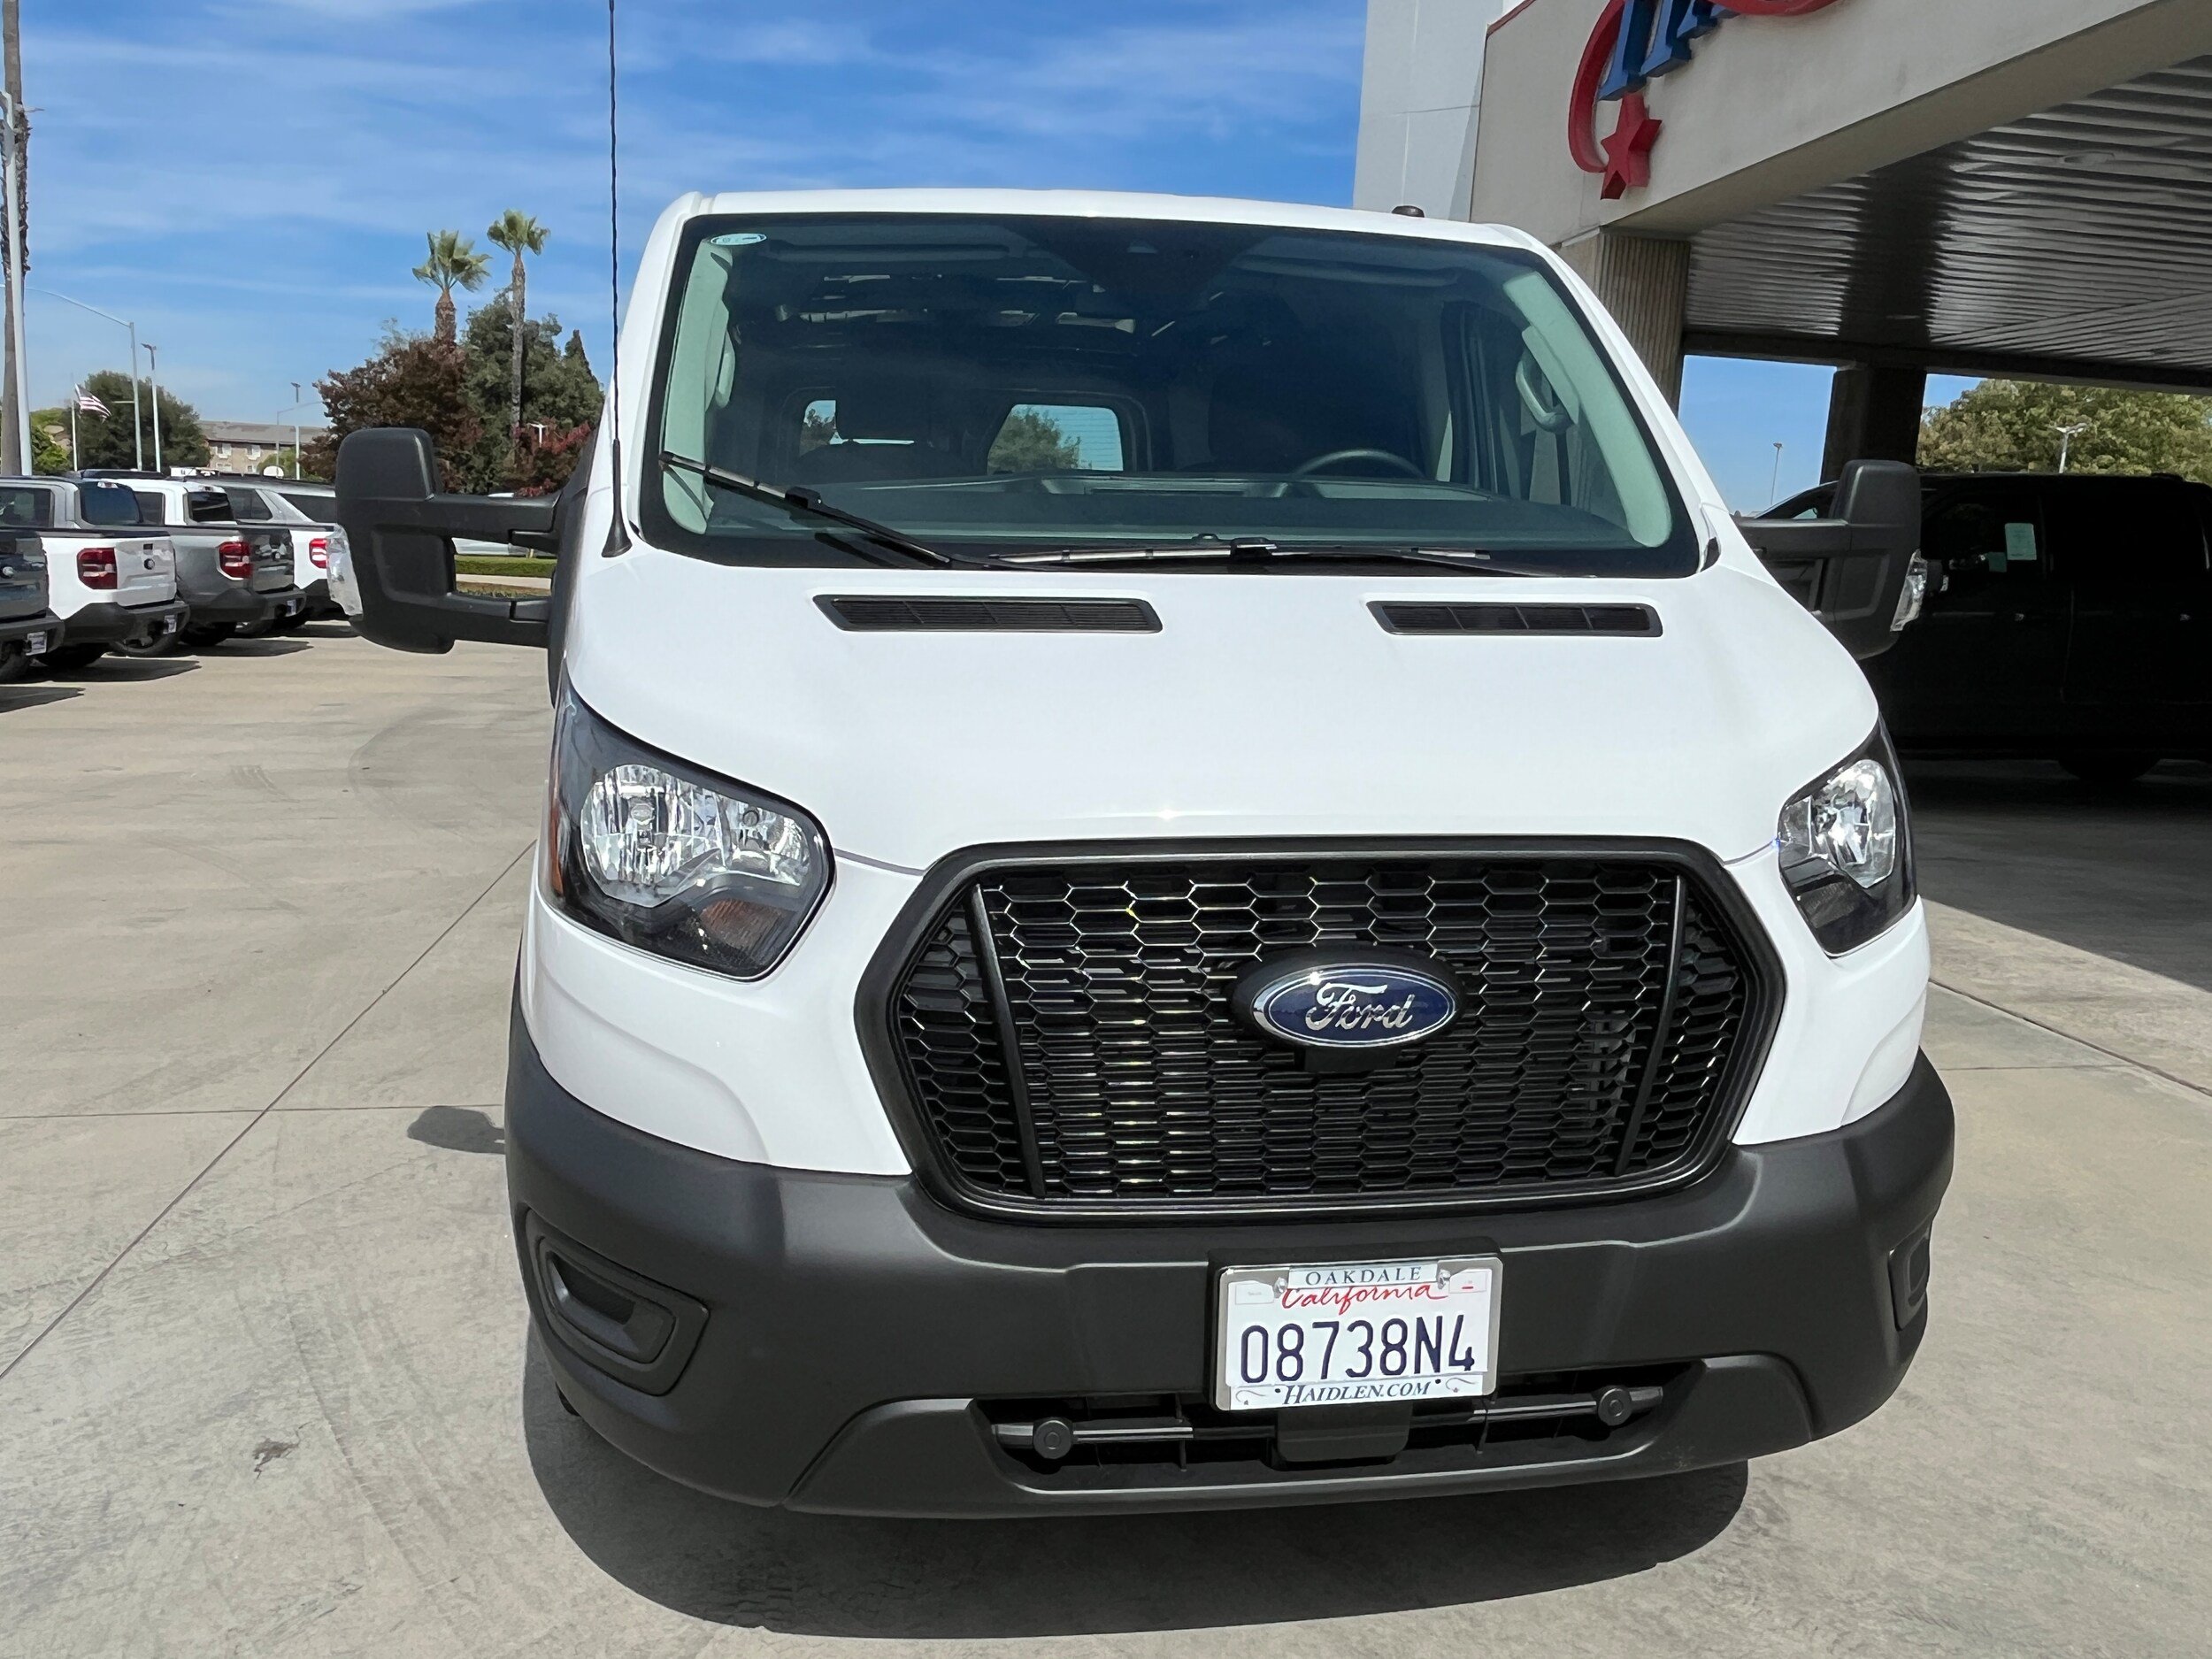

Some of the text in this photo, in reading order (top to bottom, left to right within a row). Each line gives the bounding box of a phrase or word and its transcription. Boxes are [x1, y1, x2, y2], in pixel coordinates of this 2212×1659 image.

[1305, 983, 1416, 1030] Ford
[1305, 1266, 1422, 1286] OAKDALE
[1281, 1284, 1448, 1316] California
[1240, 1314, 1475, 1383] 08738N4
[1282, 1381, 1431, 1405] HAIDLEN.COM
